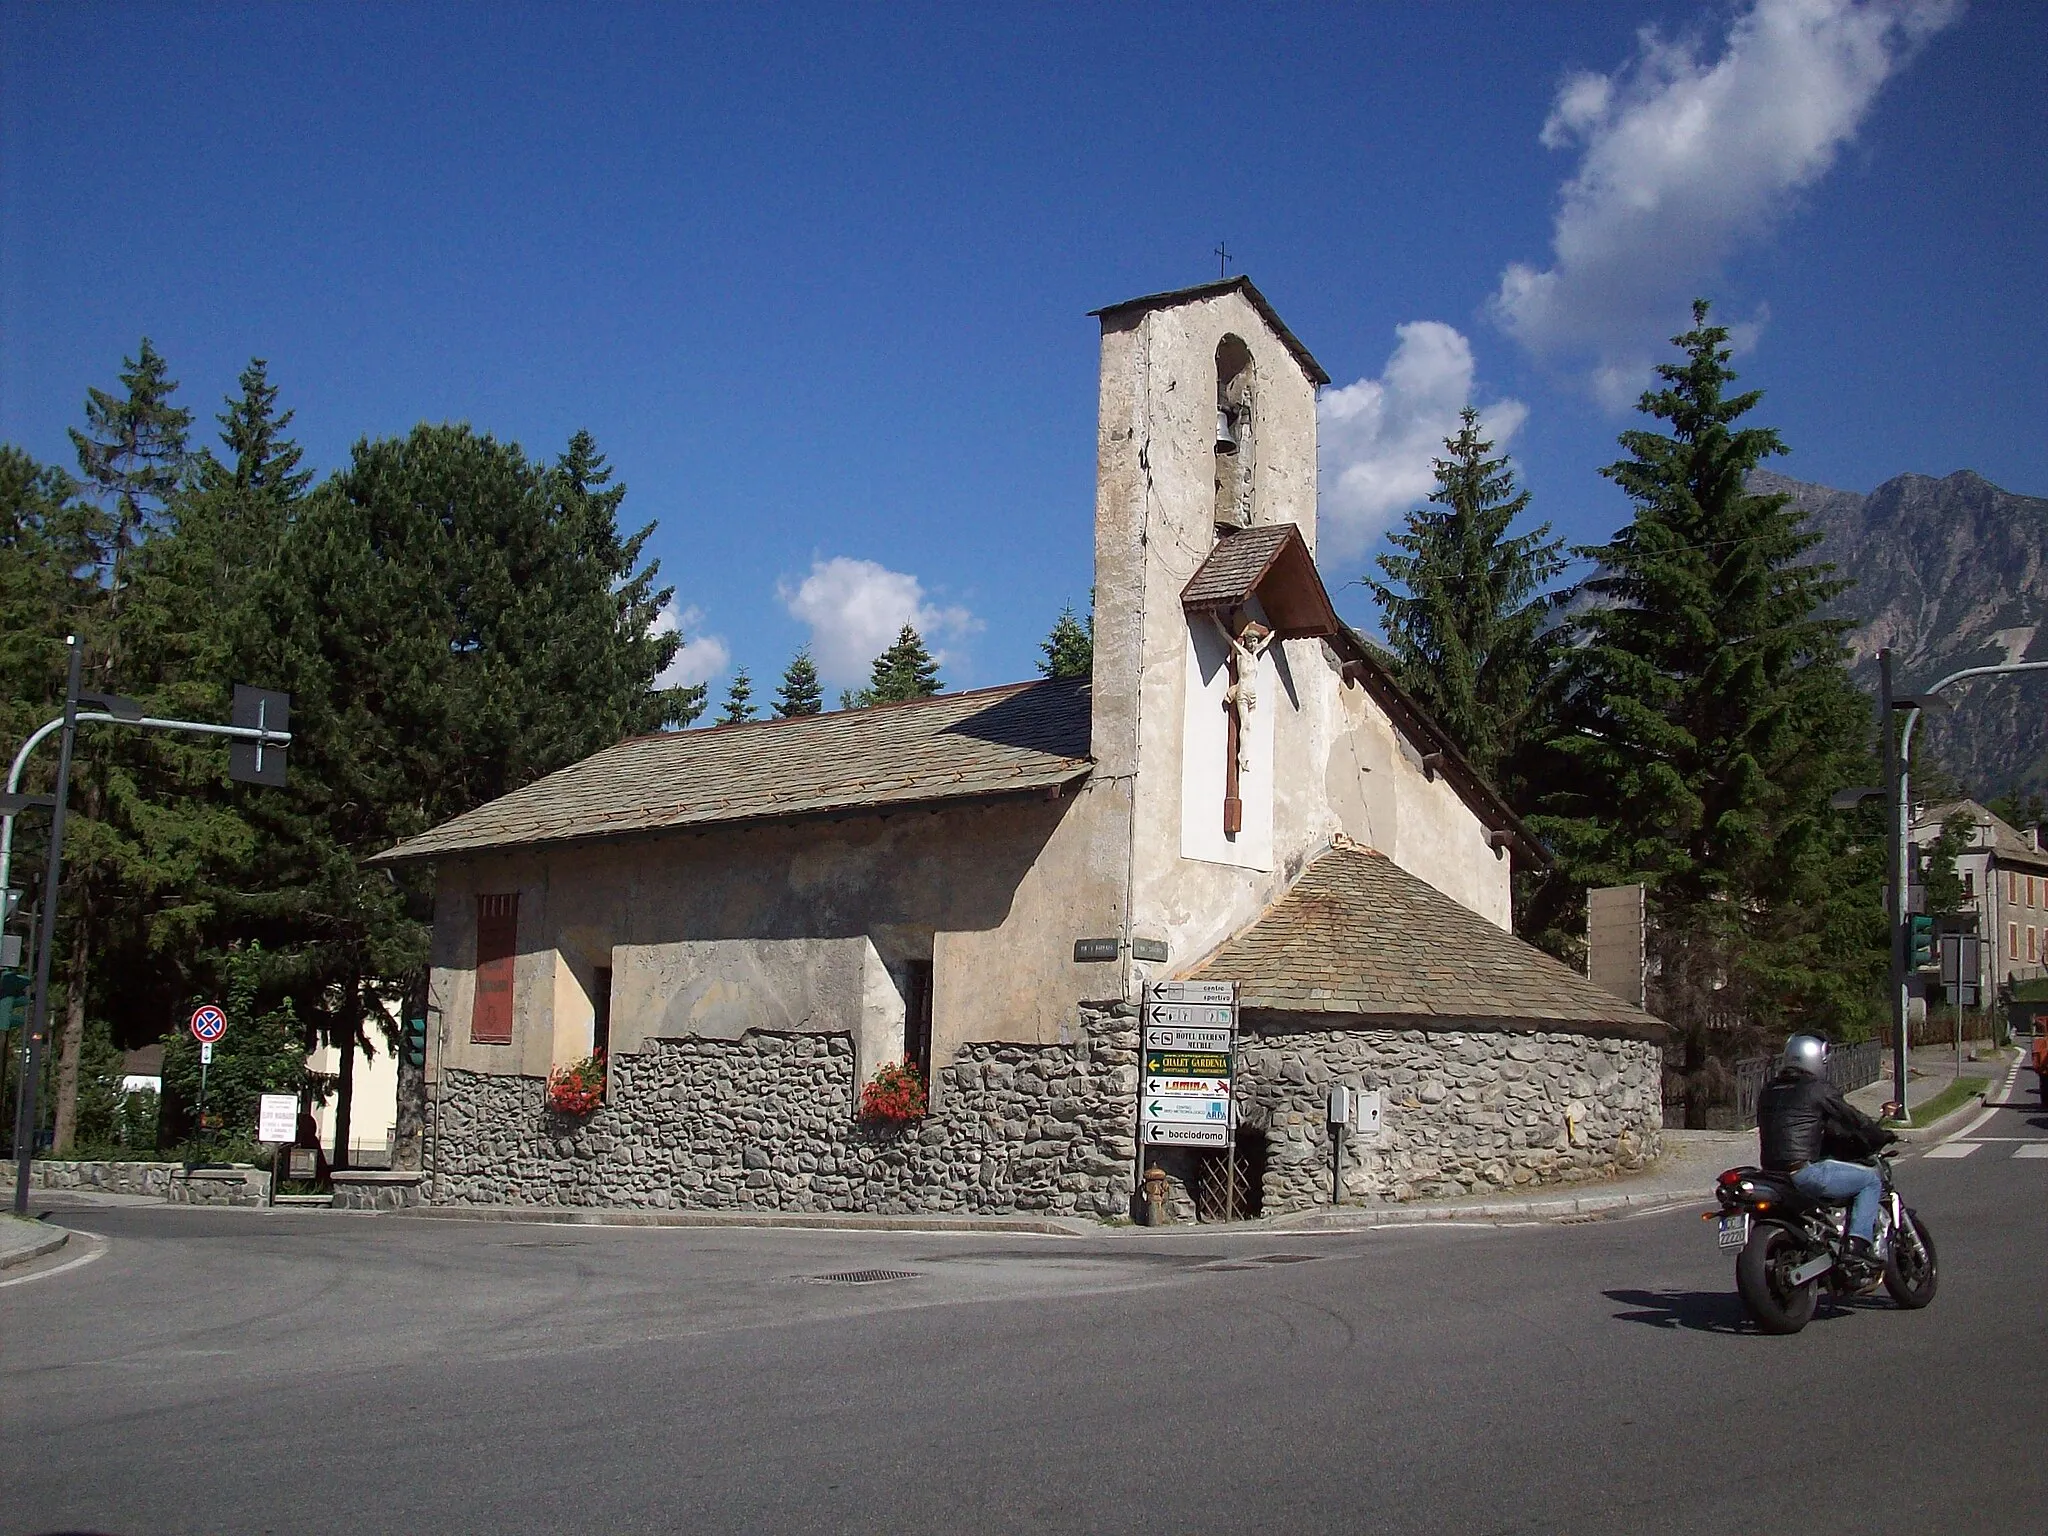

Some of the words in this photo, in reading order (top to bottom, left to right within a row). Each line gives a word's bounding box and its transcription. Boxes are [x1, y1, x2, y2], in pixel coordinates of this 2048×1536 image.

[1176, 1032, 1197, 1040] HOTEL
[1198, 1033, 1226, 1041] EVEREST
[1162, 1057, 1189, 1067] CHALET
[1191, 1058, 1227, 1068] GARDENIA
[1205, 1112, 1226, 1120] ARPA
[1168, 1129, 1223, 1140] bocciodromo
